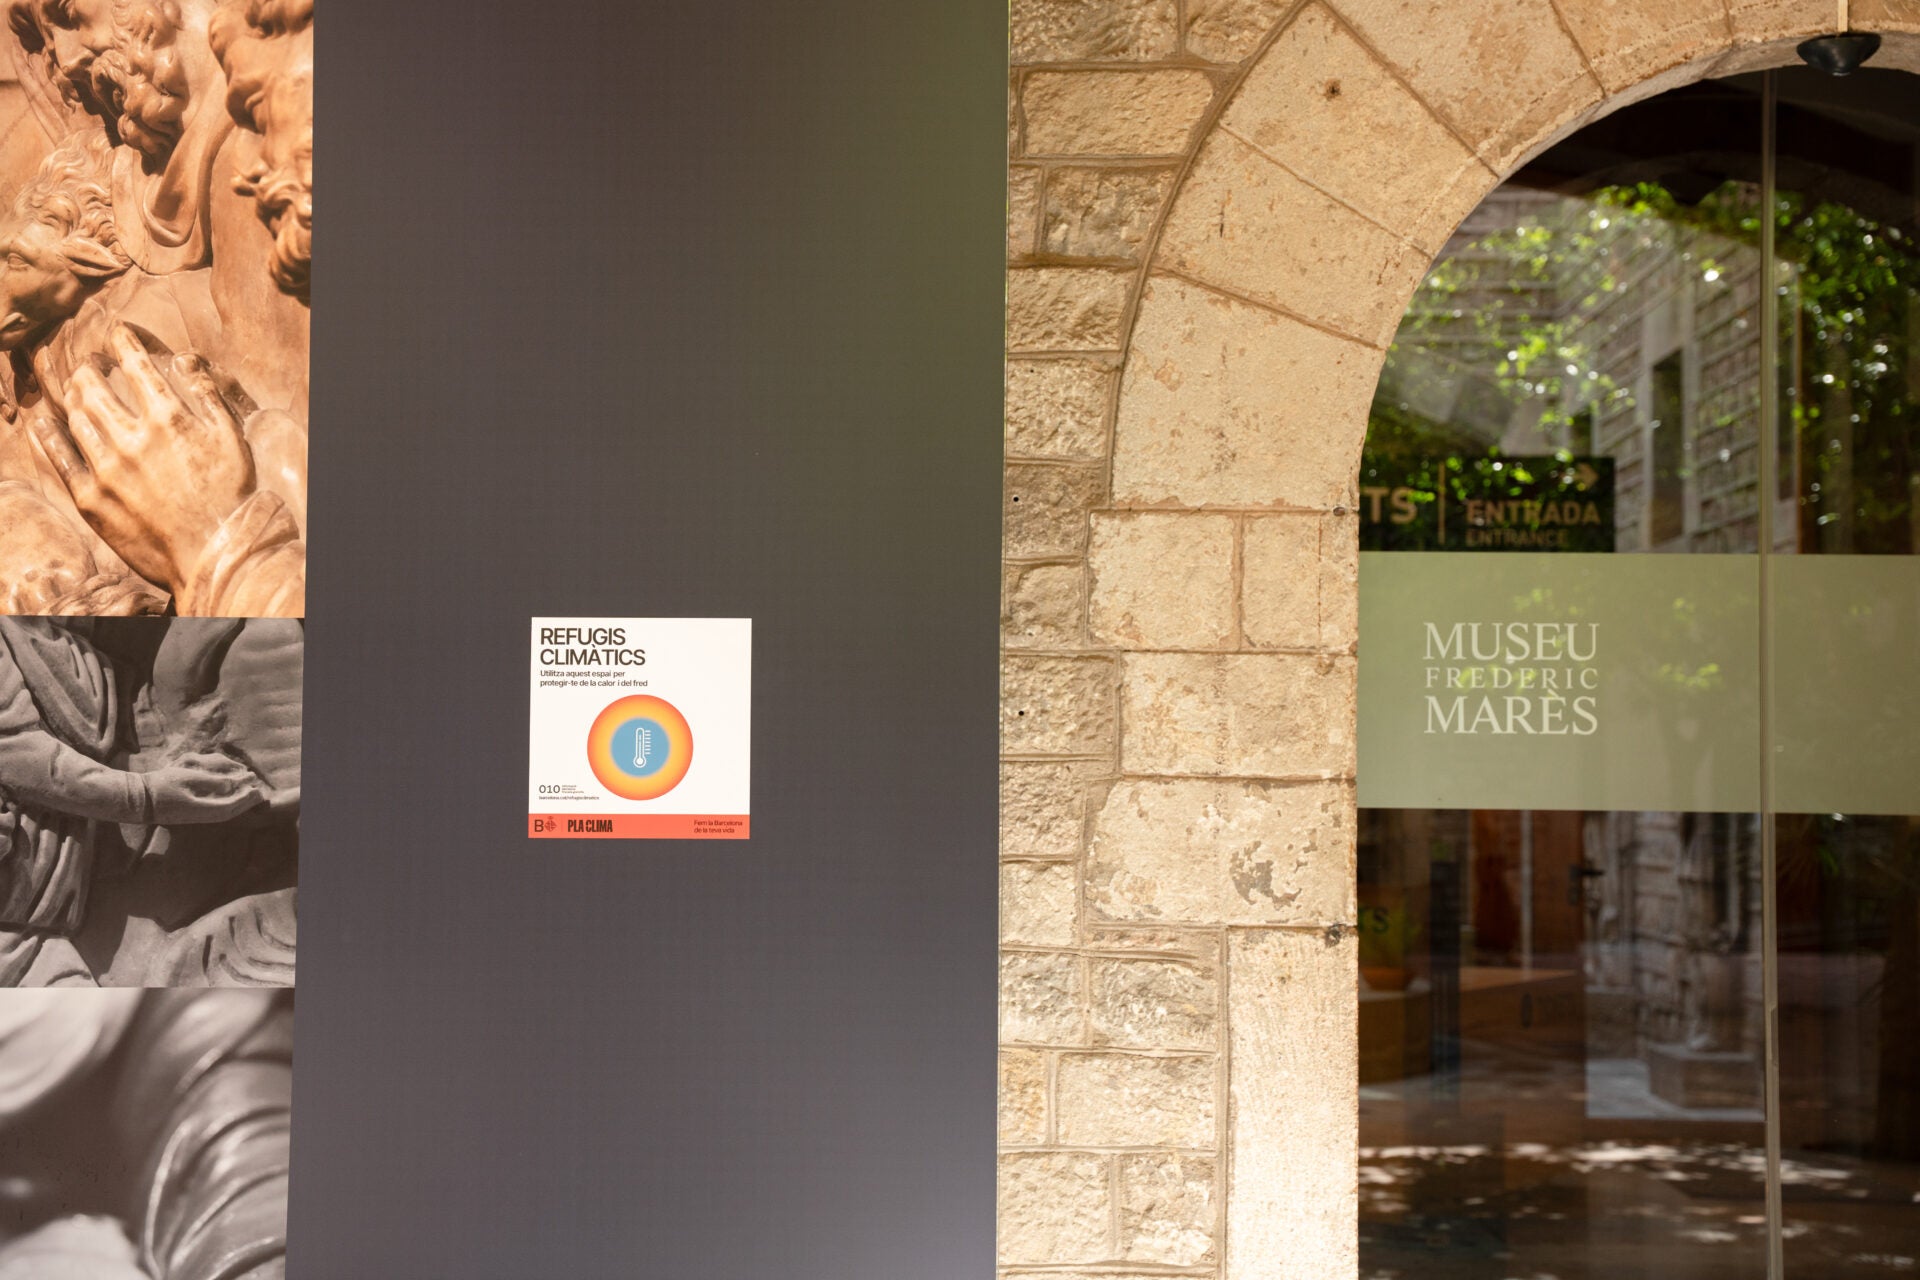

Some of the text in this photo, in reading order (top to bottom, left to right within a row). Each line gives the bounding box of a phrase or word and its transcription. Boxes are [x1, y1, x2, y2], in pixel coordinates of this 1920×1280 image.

[1466, 501, 1600, 525] ENTRADA
[1466, 529, 1568, 546] ENTRANCE
[540, 627, 626, 646] REFUGIS
[1423, 622, 1600, 661] MUSEU
[540, 644, 646, 666] CLIMÀTICS
[565, 670, 590, 679] aquest
[591, 670, 612, 679] espai
[613, 671, 626, 679] per
[1425, 667, 1598, 689] FREDERIC
[540, 680, 579, 688] protegir-te
[1424, 689, 1598, 735] MARÈS
[538, 784, 561, 794] 010
[534, 819, 544, 832] B
[567, 819, 614, 833] PLA CLIMA
